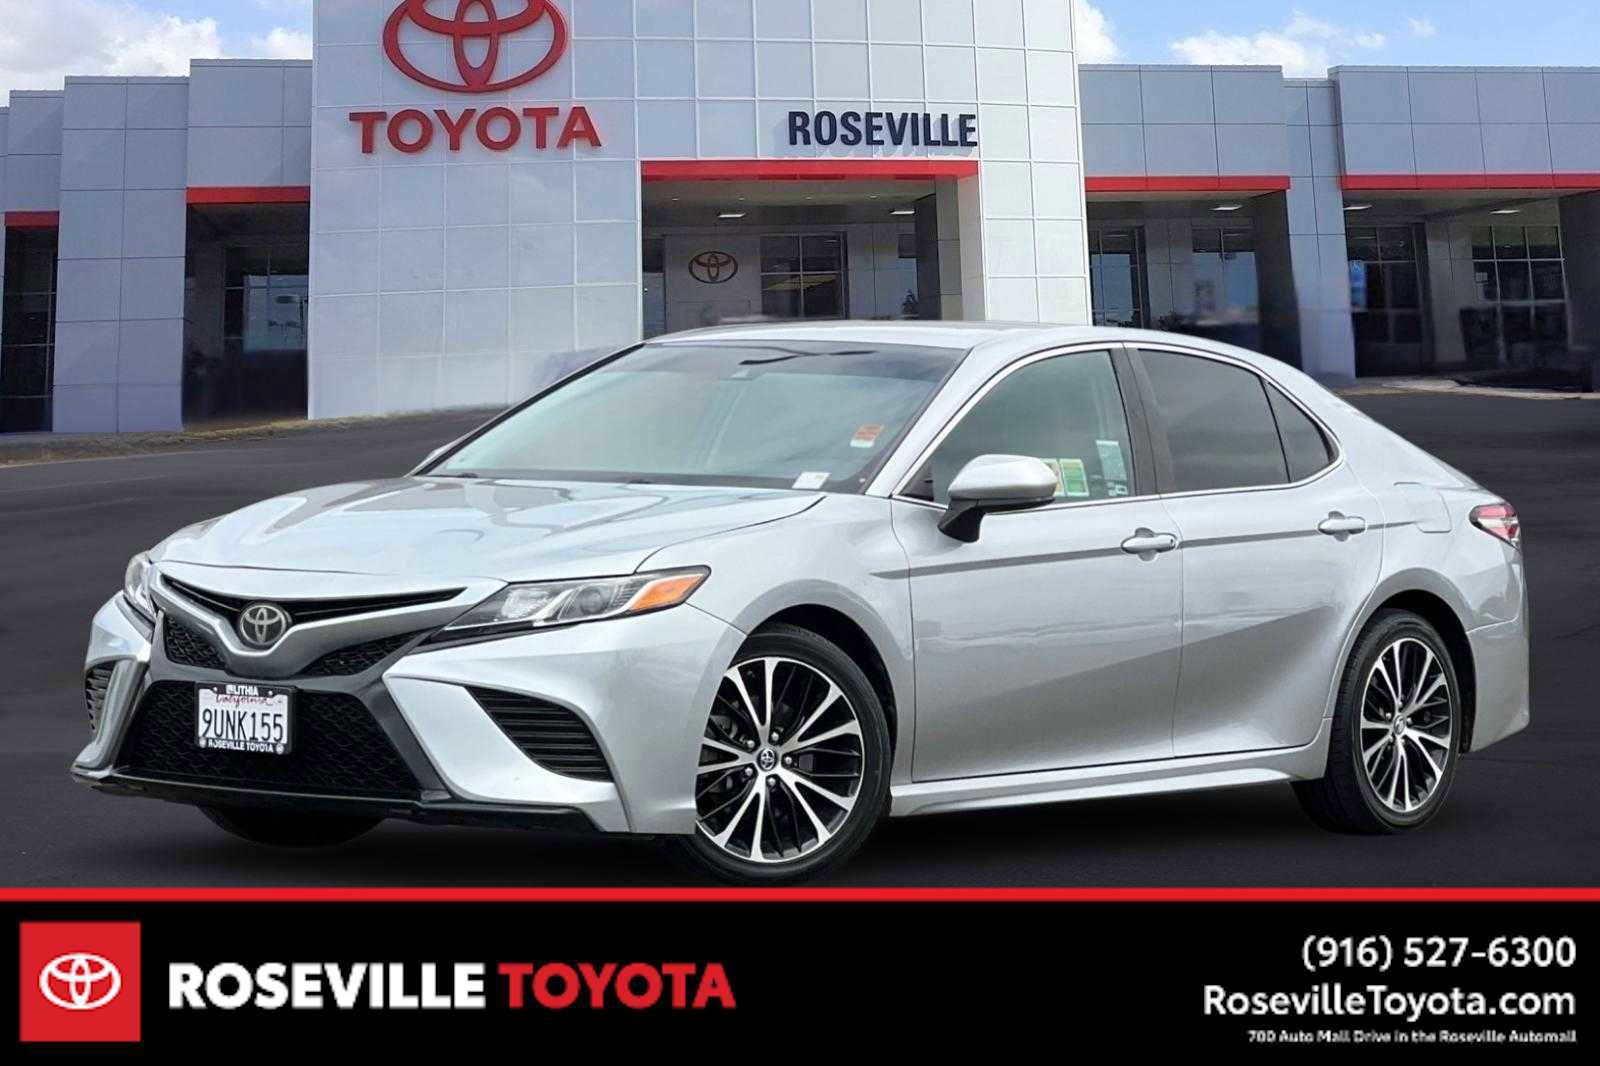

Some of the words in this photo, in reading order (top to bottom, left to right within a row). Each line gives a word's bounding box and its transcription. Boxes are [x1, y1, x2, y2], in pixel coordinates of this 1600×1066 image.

[349, 106, 602, 154] TOYOTA
[788, 111, 978, 147] ROSEVILLE
[202, 708, 283, 742] 9UNK155
[208, 739, 245, 751] ROSEVILLE
[246, 742, 274, 753] TOYOTA
